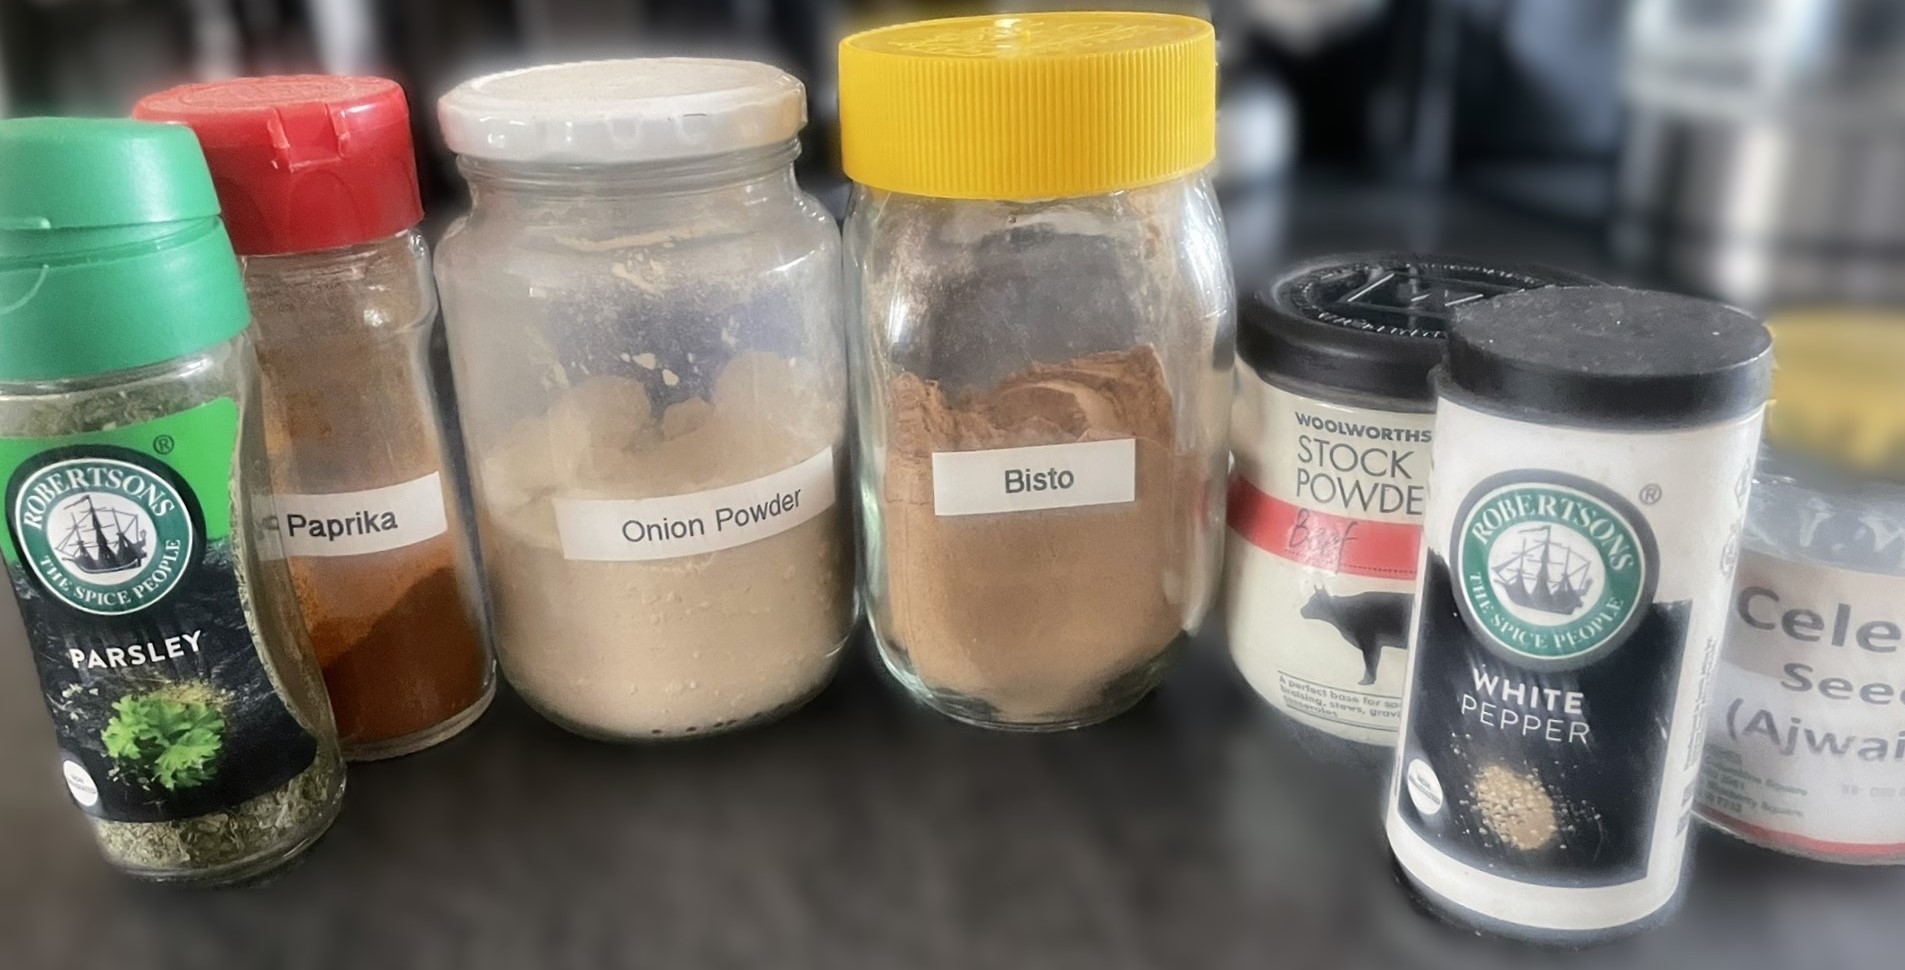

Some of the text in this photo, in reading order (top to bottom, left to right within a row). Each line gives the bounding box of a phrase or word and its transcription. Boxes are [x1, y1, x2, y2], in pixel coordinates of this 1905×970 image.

[1294, 411, 1433, 443] WOOLWORTHS
[1004, 467, 1075, 494] Bisto
[1297, 434, 1415, 480] STOCK
[24, 467, 176, 530] ROBERTSONS
[621, 488, 802, 543] Onion Powder
[1295, 467, 1424, 516] POWDE
[286, 510, 399, 542] Paprika
[1471, 494, 1634, 571] ROBERTSONS
[40, 538, 181, 606] THE SPICE PEOPLE
[1469, 571, 1624, 649] THE SPICE PEOPLE
[1737, 585, 1903, 653] Cele
[68, 629, 202, 669] PARSLEY
[1288, 680, 1327, 697] perfect
[1330, 690, 1360, 705] base
[1363, 697, 1382, 708] for
[1473, 667, 1584, 715] WHITE
[1780, 662, 1905, 706] See
[1370, 708, 1401, 719] gravi
[1461, 693, 1590, 745] PEPPER
[1726, 697, 1905, 762] (Ajwai
